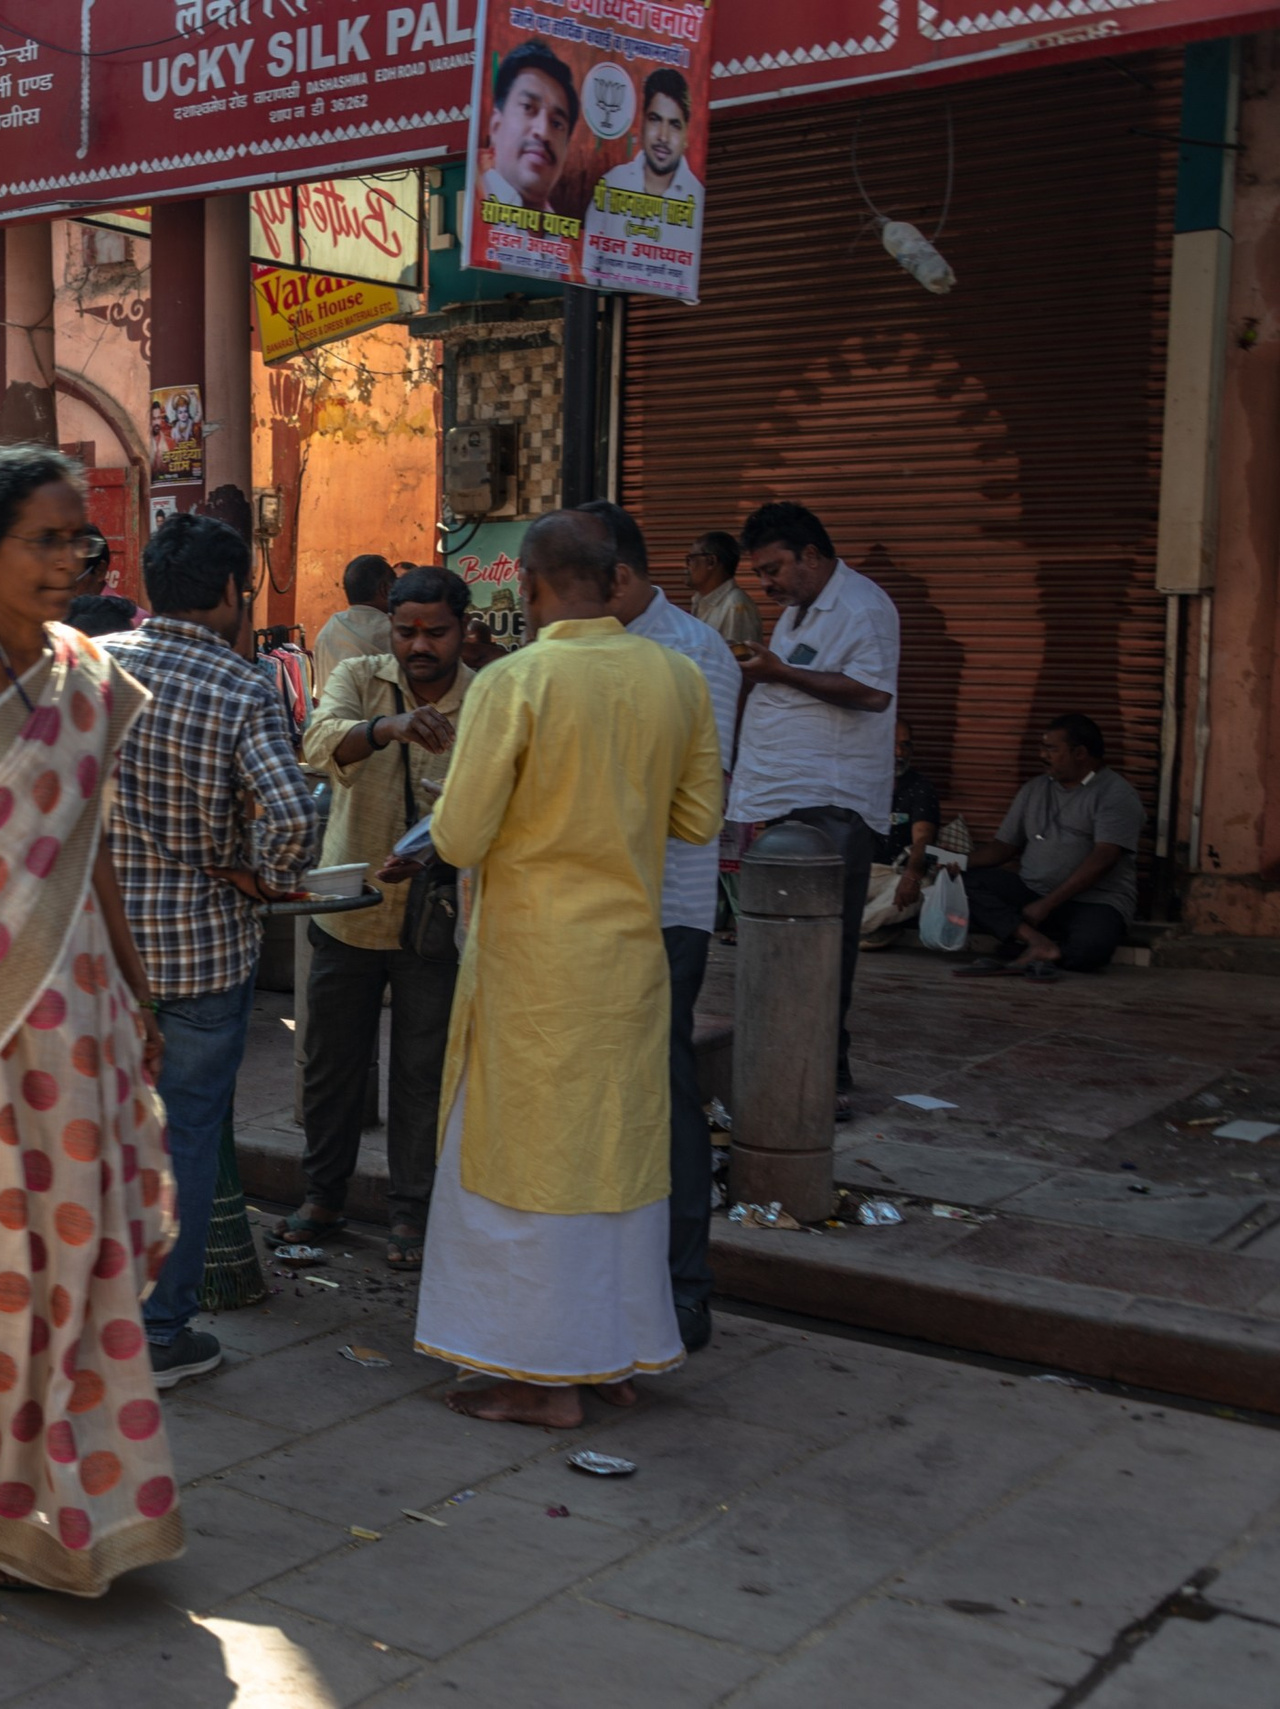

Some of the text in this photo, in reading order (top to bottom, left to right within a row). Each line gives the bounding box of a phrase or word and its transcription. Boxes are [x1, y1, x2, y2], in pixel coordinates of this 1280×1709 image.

[142, 39, 254, 102] UCKY
[267, 14, 371, 77] SILK
[481, 194, 582, 239] सोमनाथ यादव
[589, 231, 694, 266] मंडल उपाध्यक्ष
[319, 292, 365, 320] House
